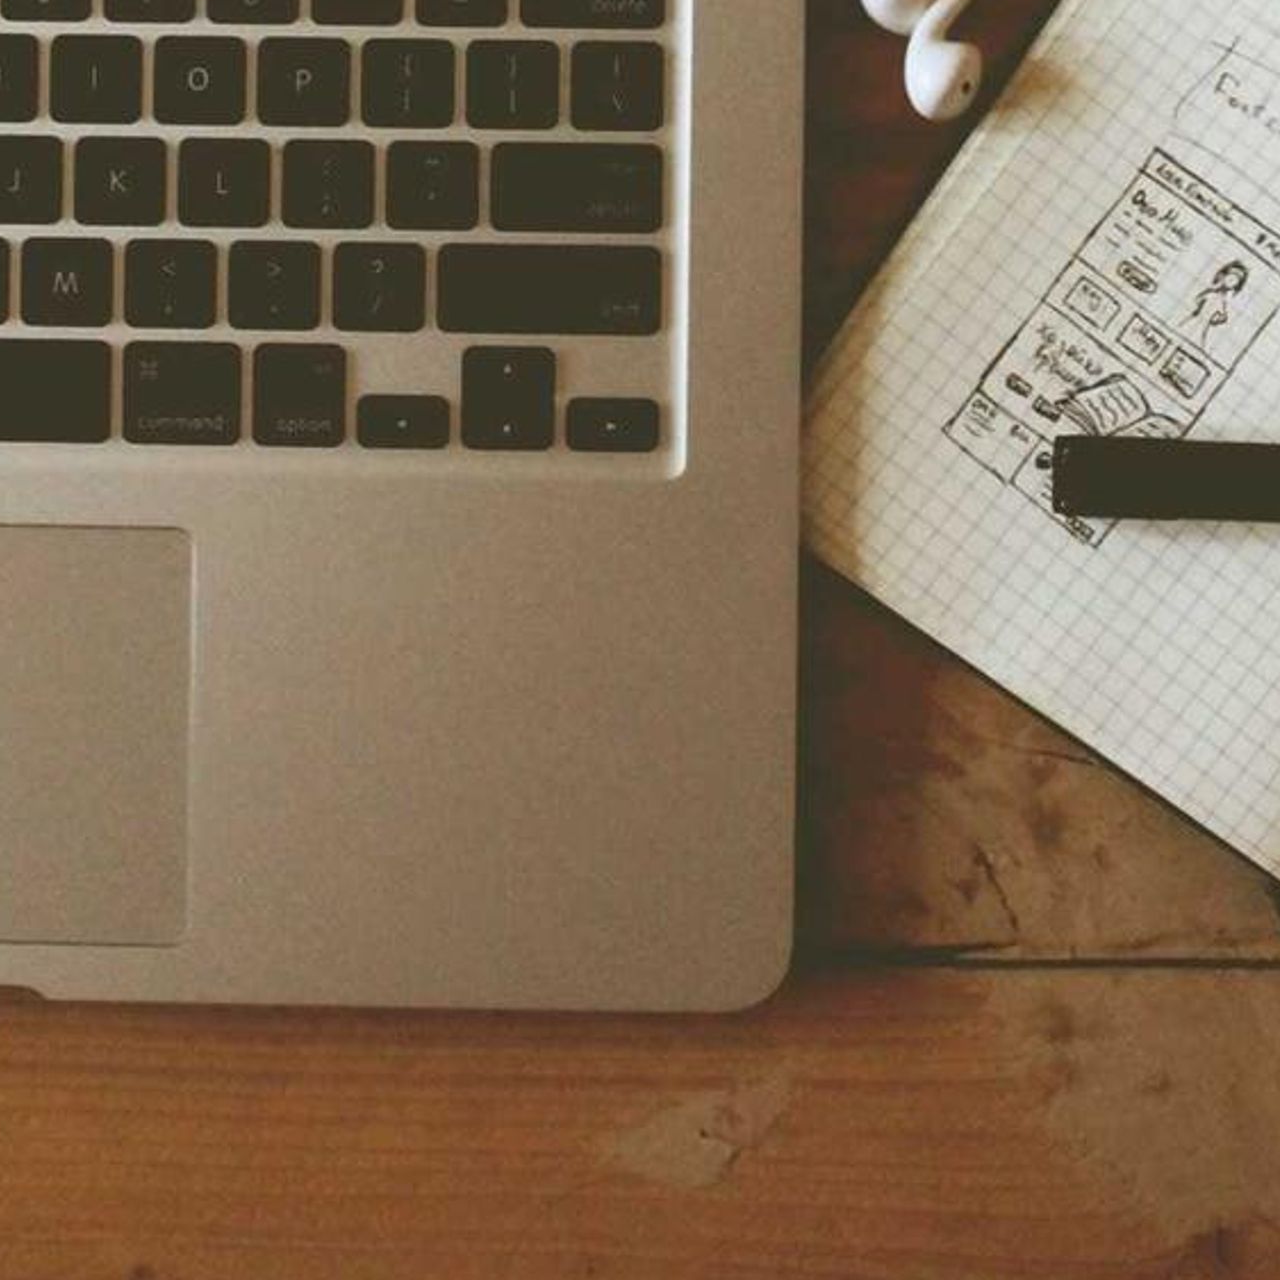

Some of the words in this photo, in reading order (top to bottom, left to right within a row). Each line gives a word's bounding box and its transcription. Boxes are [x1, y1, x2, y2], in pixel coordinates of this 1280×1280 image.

[187, 66, 210, 92] O
[295, 68, 313, 92] P
[7, 168, 21, 193] J
[110, 170, 126, 192] K
[215, 171, 229, 196] L
[52, 271, 79, 294] M
